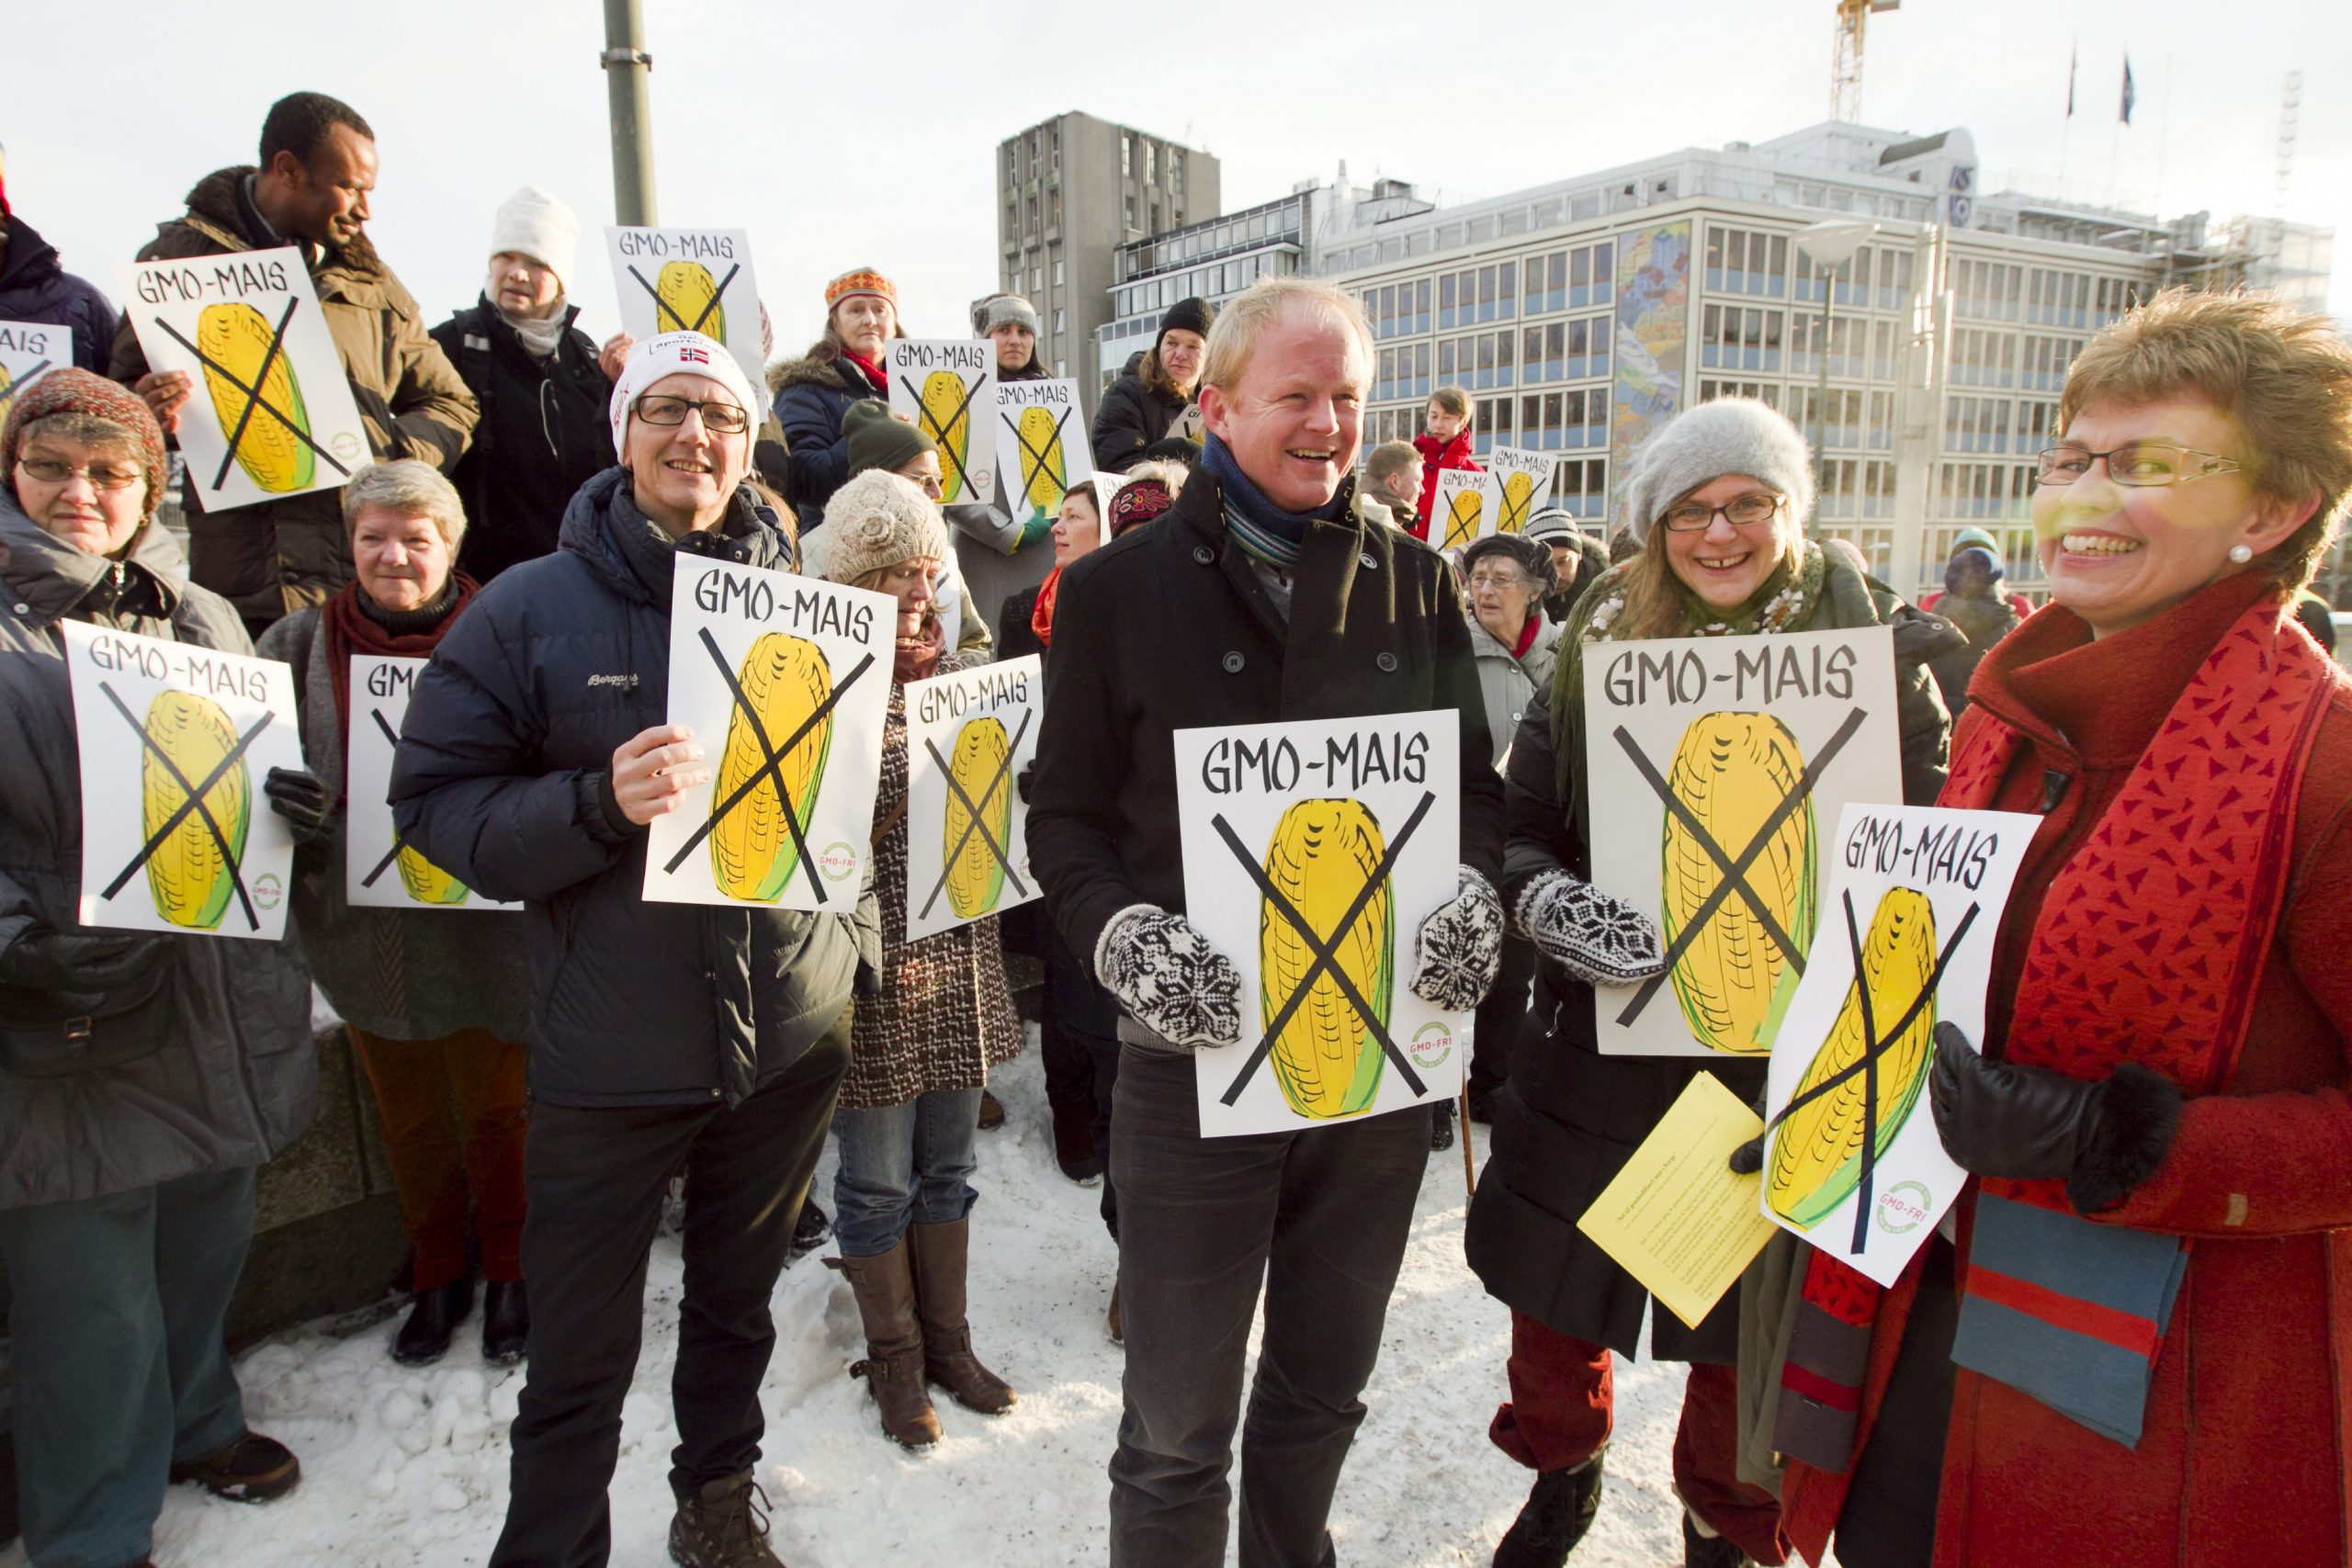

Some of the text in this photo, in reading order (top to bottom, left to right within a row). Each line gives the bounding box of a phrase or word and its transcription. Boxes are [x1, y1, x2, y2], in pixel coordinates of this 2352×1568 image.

[619, 231, 734, 259] GMO-MAIS
[137, 262, 289, 305] GMO-MAIS
[896, 345, 984, 371] GMO-MAIS
[996, 385, 1068, 404] GMO-MAIS
[1495, 449, 1549, 475] GMO-MAIS
[695, 569, 874, 644] GMO-MAIS
[89, 634, 267, 703] GMO-MAIS
[1604, 644, 1857, 706] GMO-MAIS
[920, 670, 1028, 724] GMO-MAIS
[1202, 732, 1430, 794] GMO-MAIS
[820, 856, 856, 867] GMO-FRI
[1846, 815, 1998, 891] GMO-MAIS
[1409, 1036, 1452, 1054] GMO-FRI
[1880, 1193, 1927, 1222] GMO-FRI
